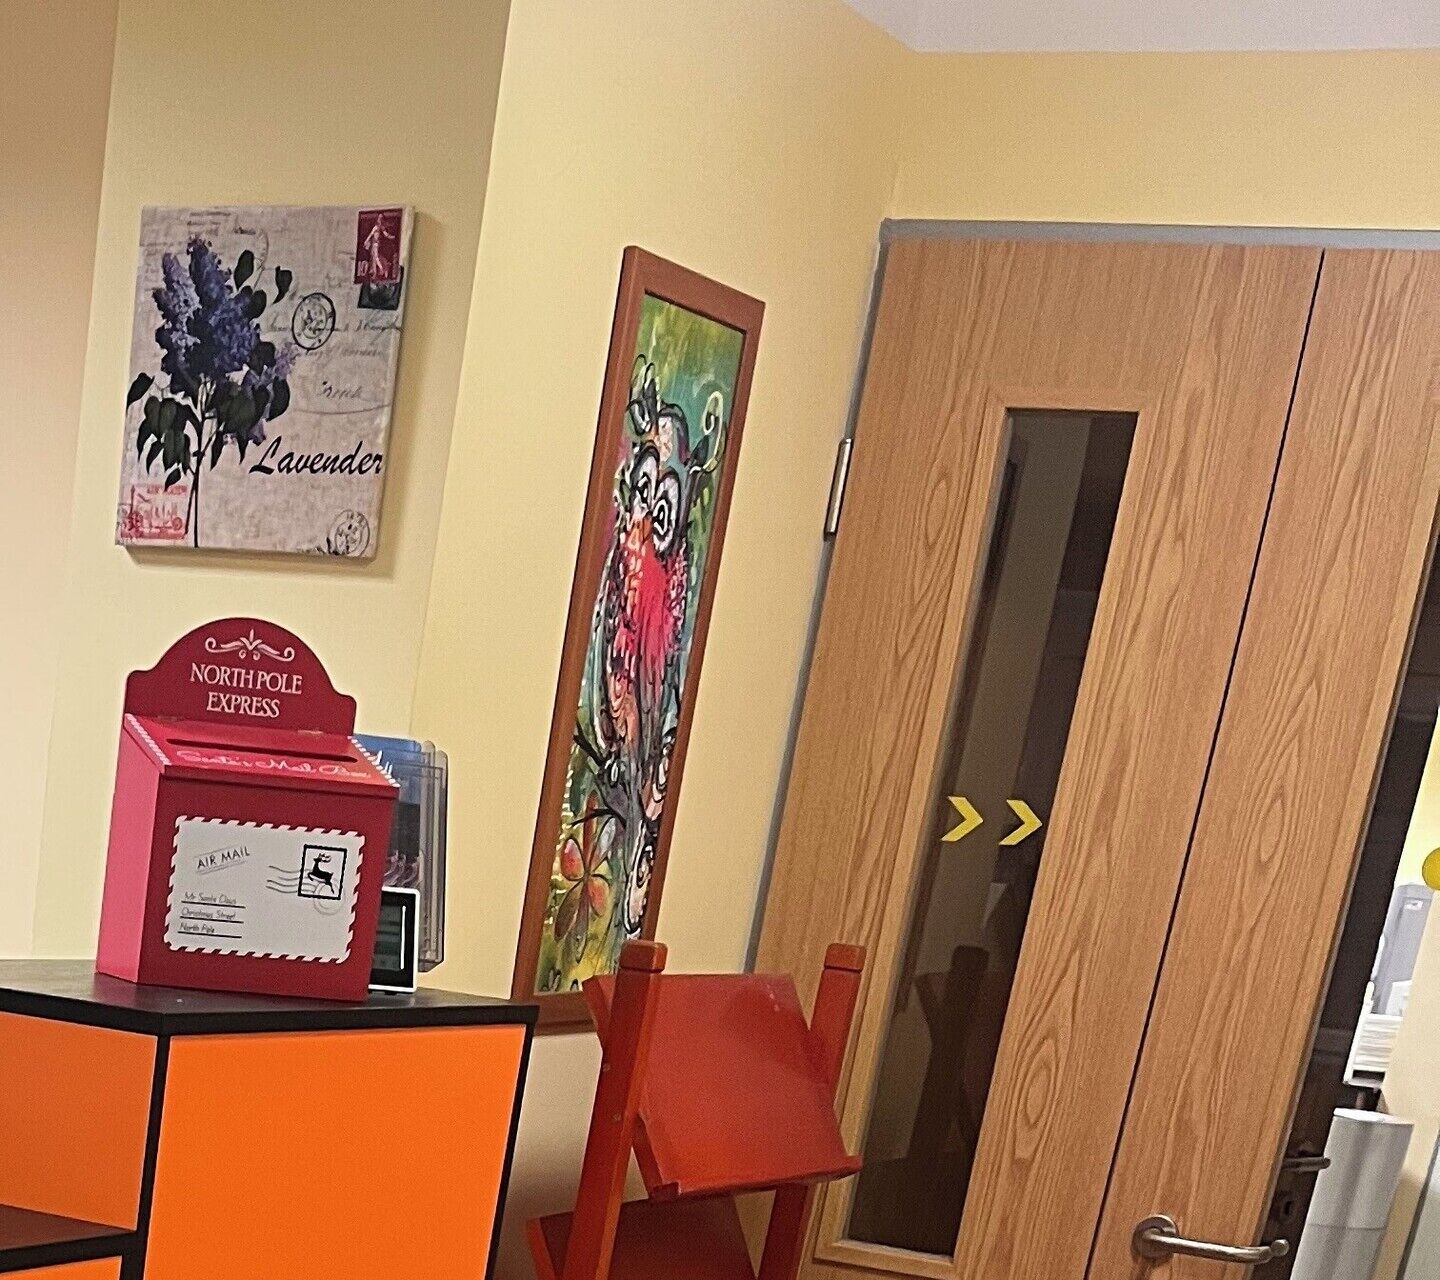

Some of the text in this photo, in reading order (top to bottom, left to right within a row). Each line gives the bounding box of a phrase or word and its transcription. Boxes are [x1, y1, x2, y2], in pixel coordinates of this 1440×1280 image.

[249, 436, 384, 475] Lavender
[189, 662, 303, 695] NORTH POLE
[206, 691, 281, 718] EXPRESS
[197, 845, 251, 870] AIR MAIL
